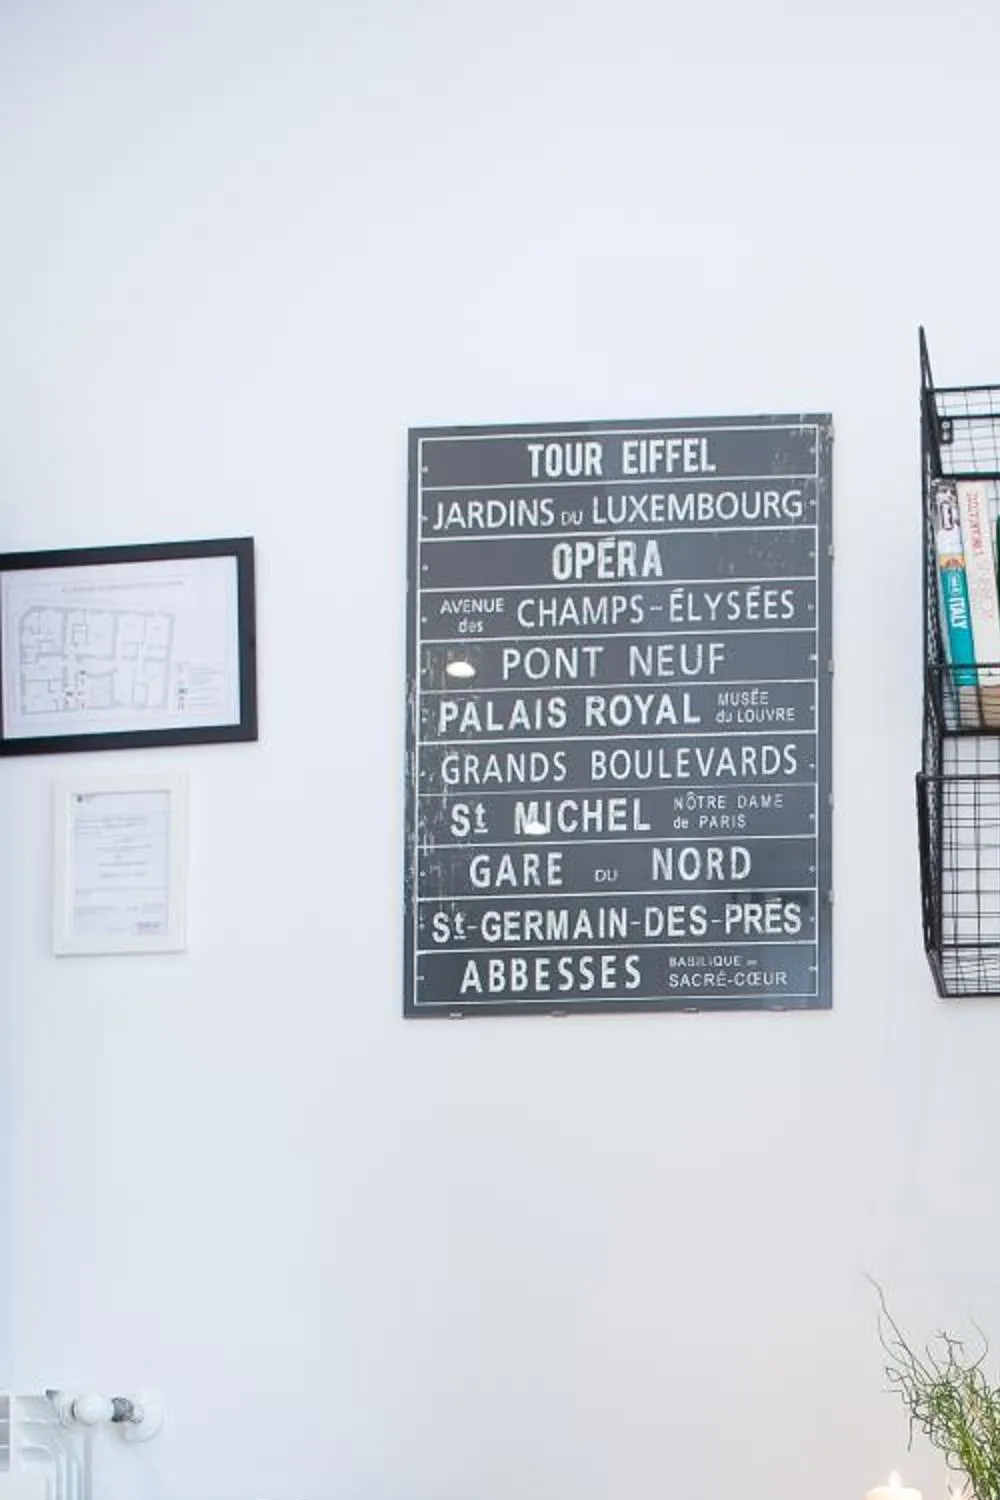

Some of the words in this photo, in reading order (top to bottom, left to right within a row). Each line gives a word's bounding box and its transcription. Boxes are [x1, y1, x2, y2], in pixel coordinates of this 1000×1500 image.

[528, 442, 602, 477] TOUR
[623, 438, 716, 474] EIFFEL
[434, 499, 554, 529] JARDINS
[562, 512, 582, 525] DU
[593, 490, 802, 523] LUXEMBOURG
[553, 537, 662, 580] OPÉRA
[440, 598, 503, 614] AVENUE
[459, 619, 483, 632] des
[503, 647, 603, 679] PONT
[630, 643, 724, 676] NEUF
[438, 697, 566, 733] PALAIS
[586, 693, 700, 726] ROYAL
[716, 710, 732, 723] du
[738, 708, 794, 722] LOUVRE
[718, 688, 768, 706] MUSÉE
[442, 752, 566, 784] GRANDS
[592, 744, 796, 780] BOULEVARDS
[451, 804, 488, 836] St
[515, 798, 650, 835] MICHEL
[738, 794, 782, 808] DAME
[674, 816, 688, 828] de
[700, 814, 745, 828] PARIS
[470, 852, 562, 887] GARE
[595, 870, 617, 882] DU
[653, 847, 750, 880] NORD
[461, 955, 640, 993] ABBESSES
